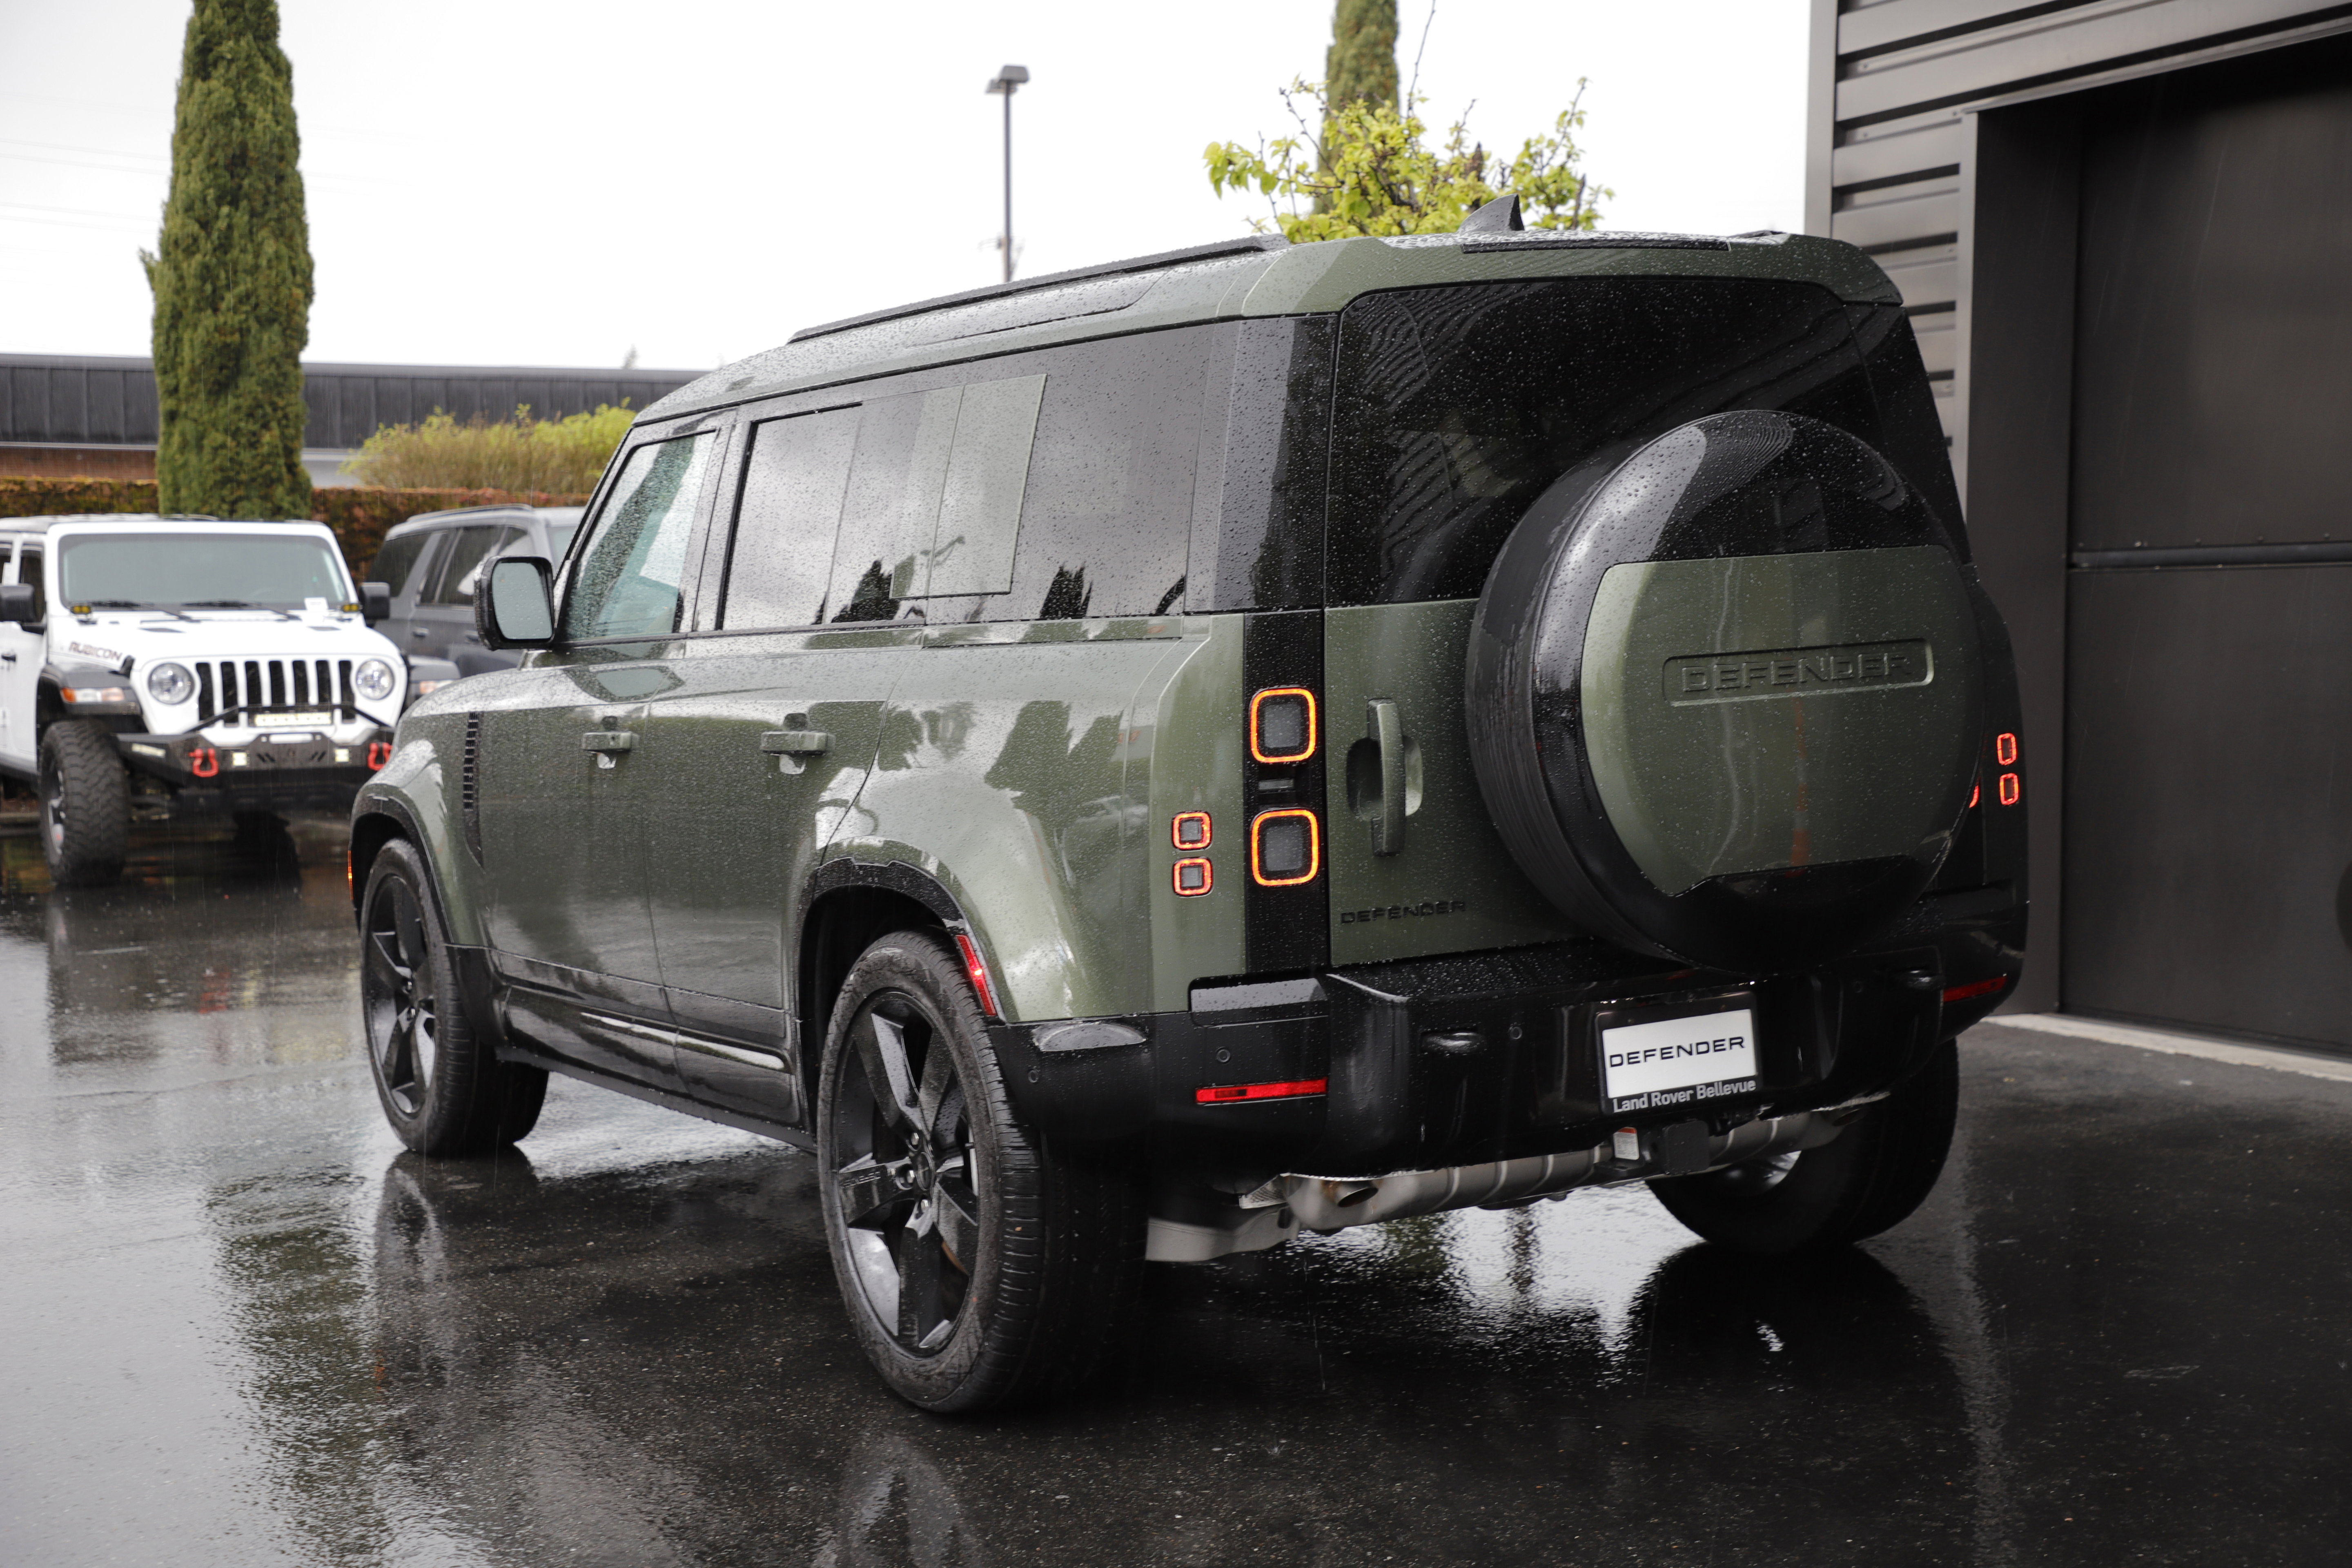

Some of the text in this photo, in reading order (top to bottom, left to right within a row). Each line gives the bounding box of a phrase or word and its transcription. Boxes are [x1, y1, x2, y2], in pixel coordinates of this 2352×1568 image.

[69, 641, 122, 661] RUBICON
[1682, 653, 1912, 693] DEFENDER
[1341, 900, 1465, 924] DEFENDER
[1609, 1036, 1745, 1068] DEFENDER
[1613, 1080, 1756, 1113] Land Rover Bellevue
